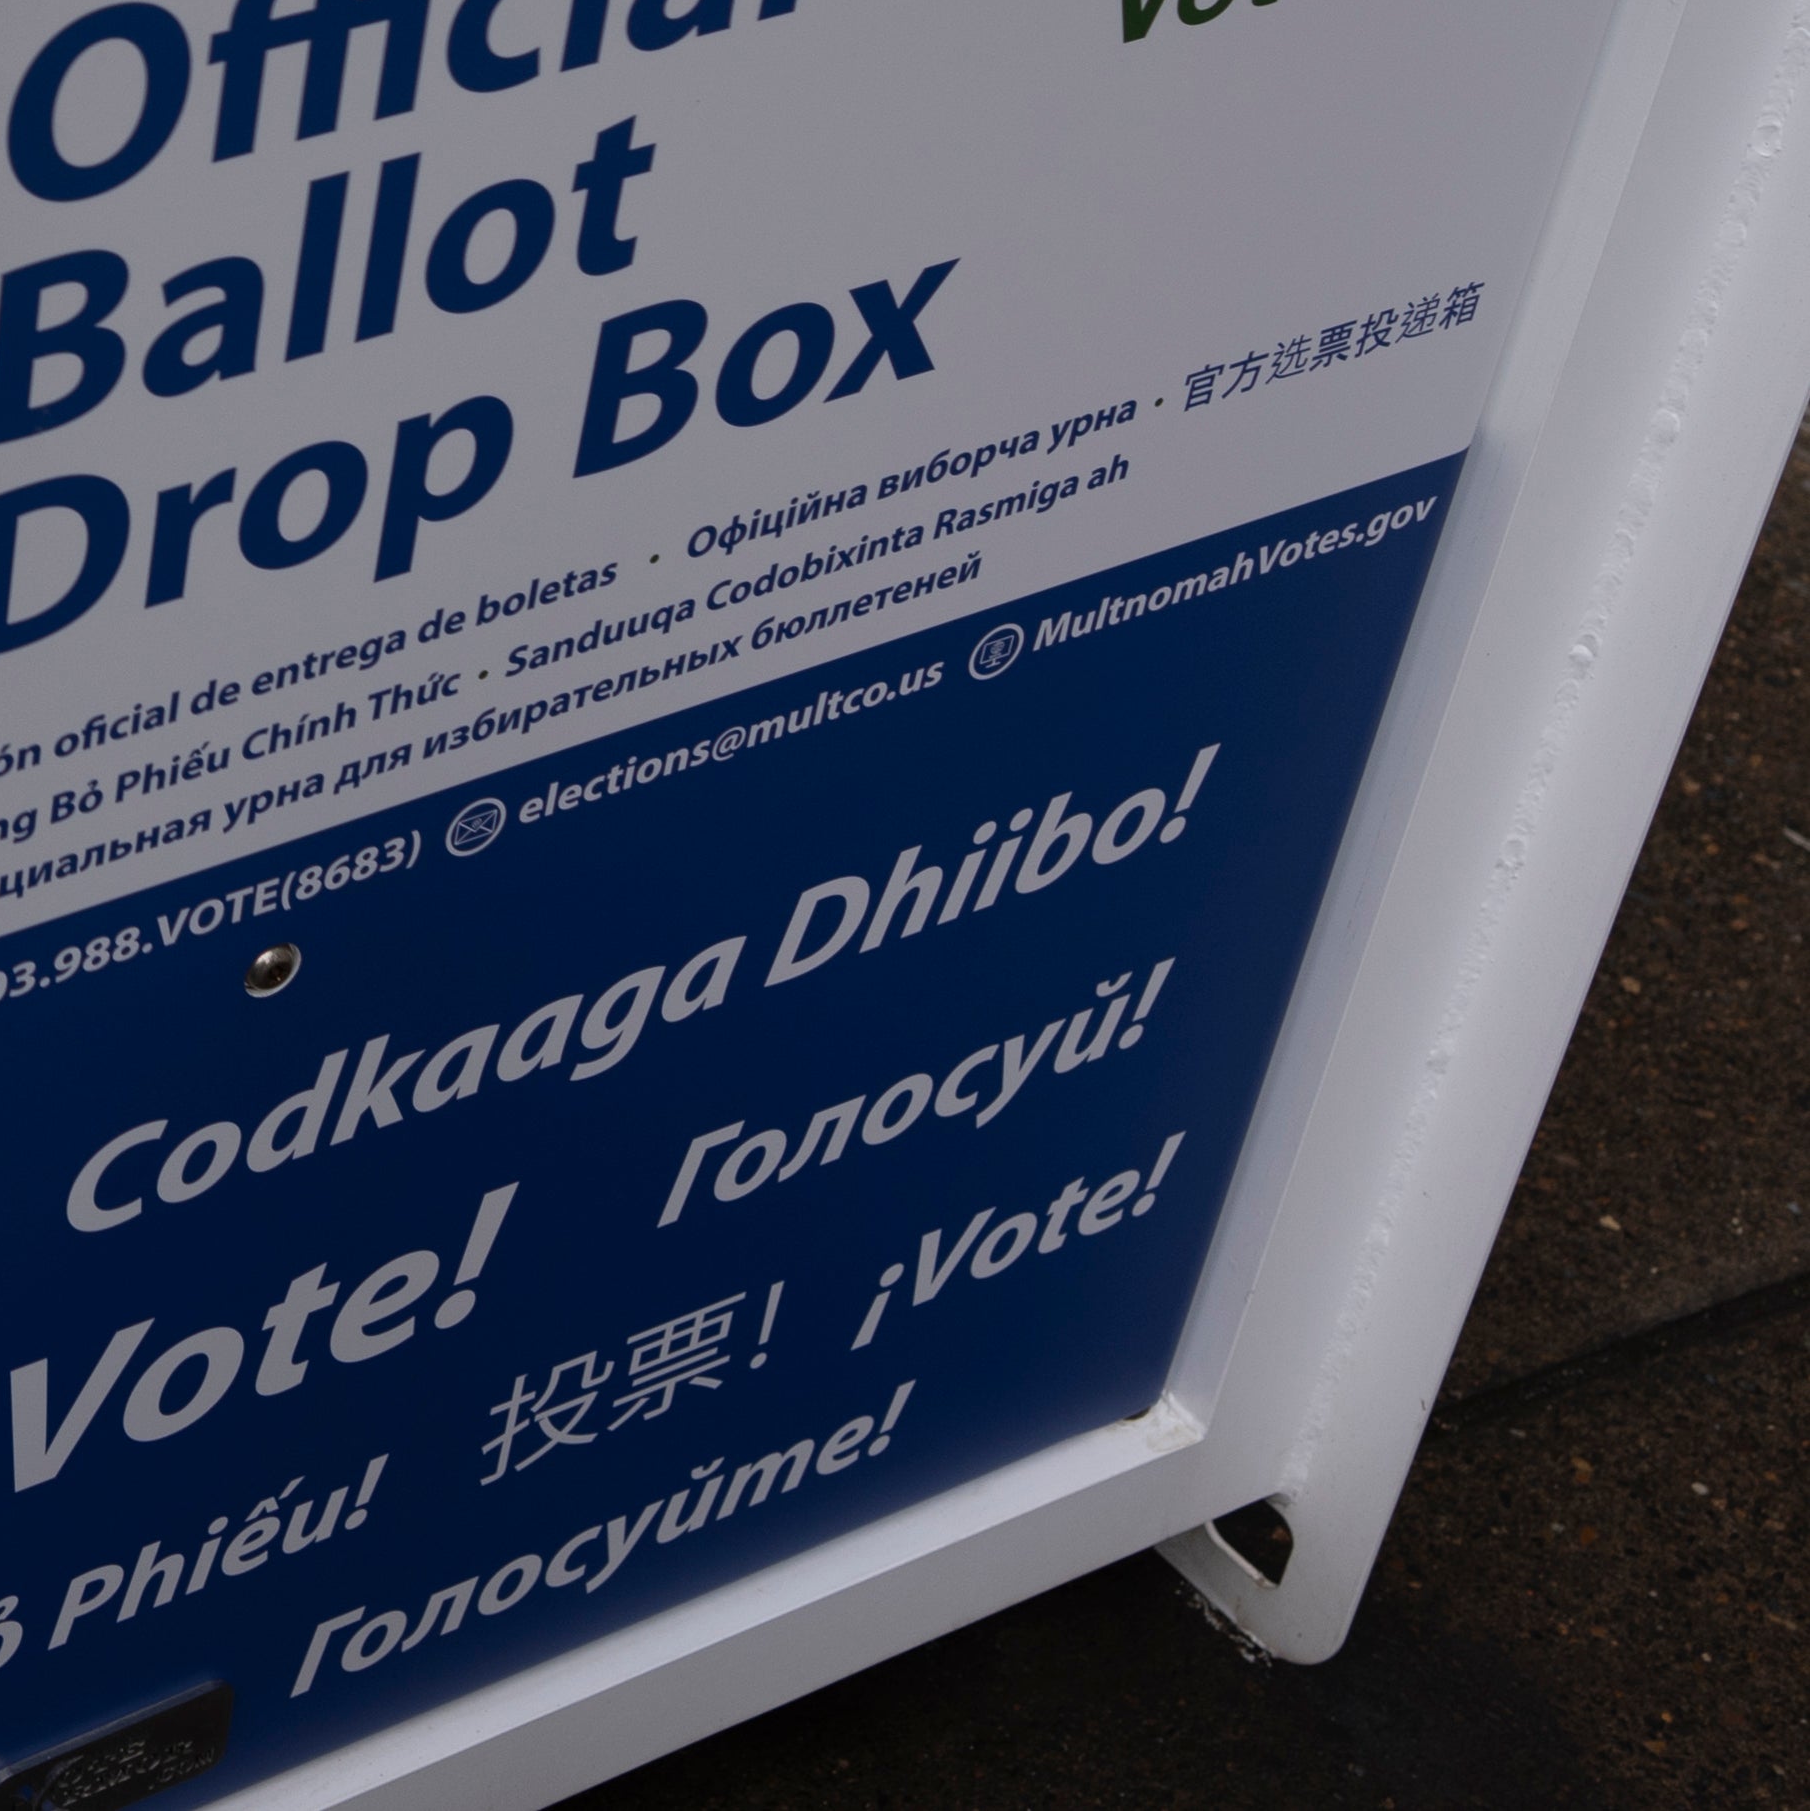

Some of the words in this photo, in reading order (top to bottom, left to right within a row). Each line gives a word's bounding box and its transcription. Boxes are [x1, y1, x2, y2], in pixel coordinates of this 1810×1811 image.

[572, 256, 960, 479] Box
[1182, 281, 1486, 413] 官方选票投递箱
[504, 594, 696, 680] Sanduuqa
[704, 527, 925, 613] Codobixinta
[932, 470, 1079, 540] Rasmiga
[1087, 453, 1130, 490] ah
[686, 481, 867, 565] Офіційна
[876, 427, 1041, 499] виборча
[1046, 397, 1137, 455] урна
[1031, 491, 1439, 652] MultnomahVotes.gov
[49, 776, 104, 824] Bỏ
[114, 740, 231, 804] Phiếu
[242, 701, 358, 762] Chính
[368, 666, 461, 723] Thức
[53, 691, 180, 761] oficial
[189, 675, 241, 718] de
[250, 627, 407, 700] entrega
[416, 604, 467, 646] de
[474, 559, 619, 627] boletas
[220, 773, 326, 840] урна
[333, 741, 412, 796] для
[421, 634, 741, 760] избирательных
[750, 550, 983, 651] бюллетеней
[517, 654, 944, 827] elections@multco.us
[63, 935, 748, 1233] Codkaaga
[763, 742, 1222, 986] Dhiibo!
[657, 956, 1177, 1230] Голосуй!
[8, 1181, 520, 1494] Vote!
[851, 1131, 1187, 1351] ¡Vote!
[46, 1453, 390, 1652] Phiếu!
[289, 1378, 917, 1698] Голосуйте!
